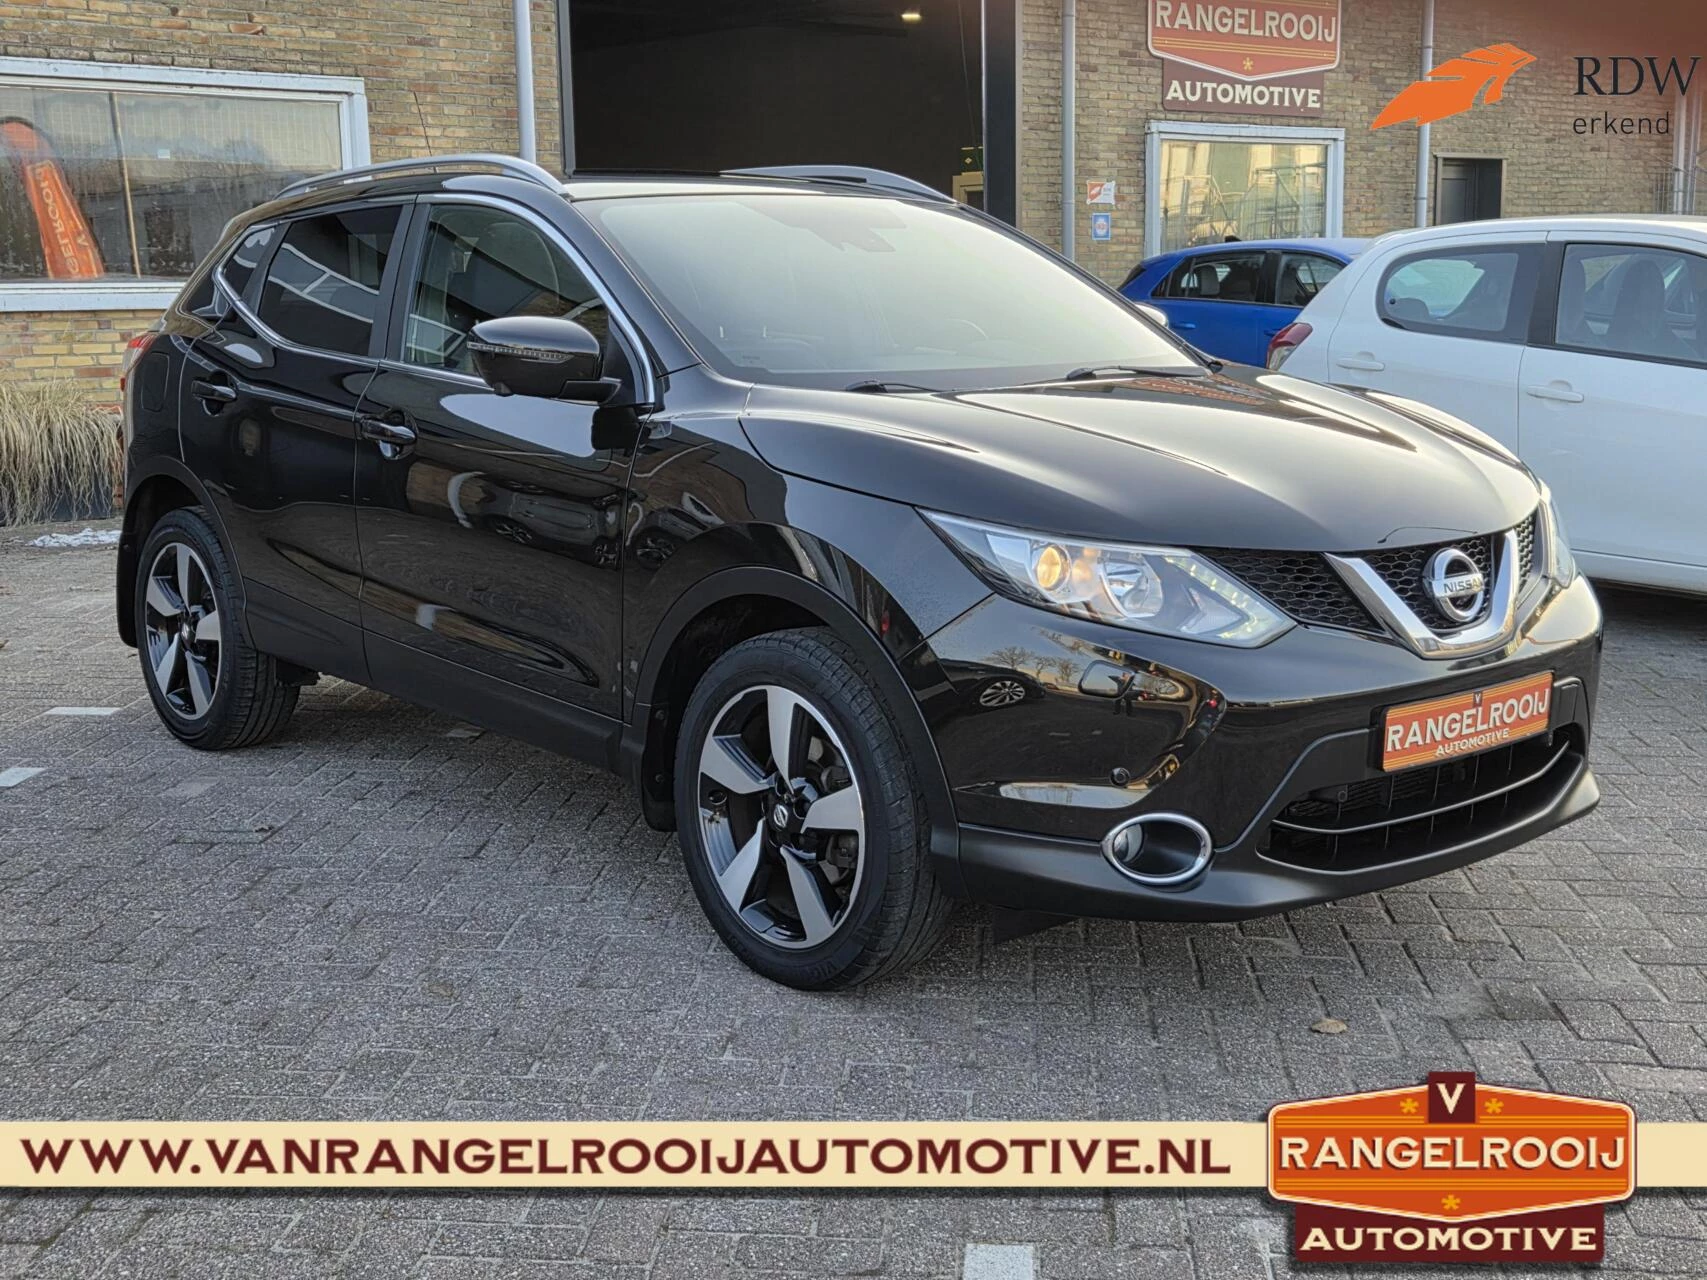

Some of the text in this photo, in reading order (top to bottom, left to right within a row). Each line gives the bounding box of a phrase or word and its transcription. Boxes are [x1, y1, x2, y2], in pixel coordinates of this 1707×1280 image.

[1155, 0, 1337, 43] RANGELROOIJ
[1165, 79, 1321, 108] AUTOMOTIVE
[1386, 688, 1550, 752] RANGELROOIJ
[1436, 728, 1510, 756] AUTOMOTIVE
